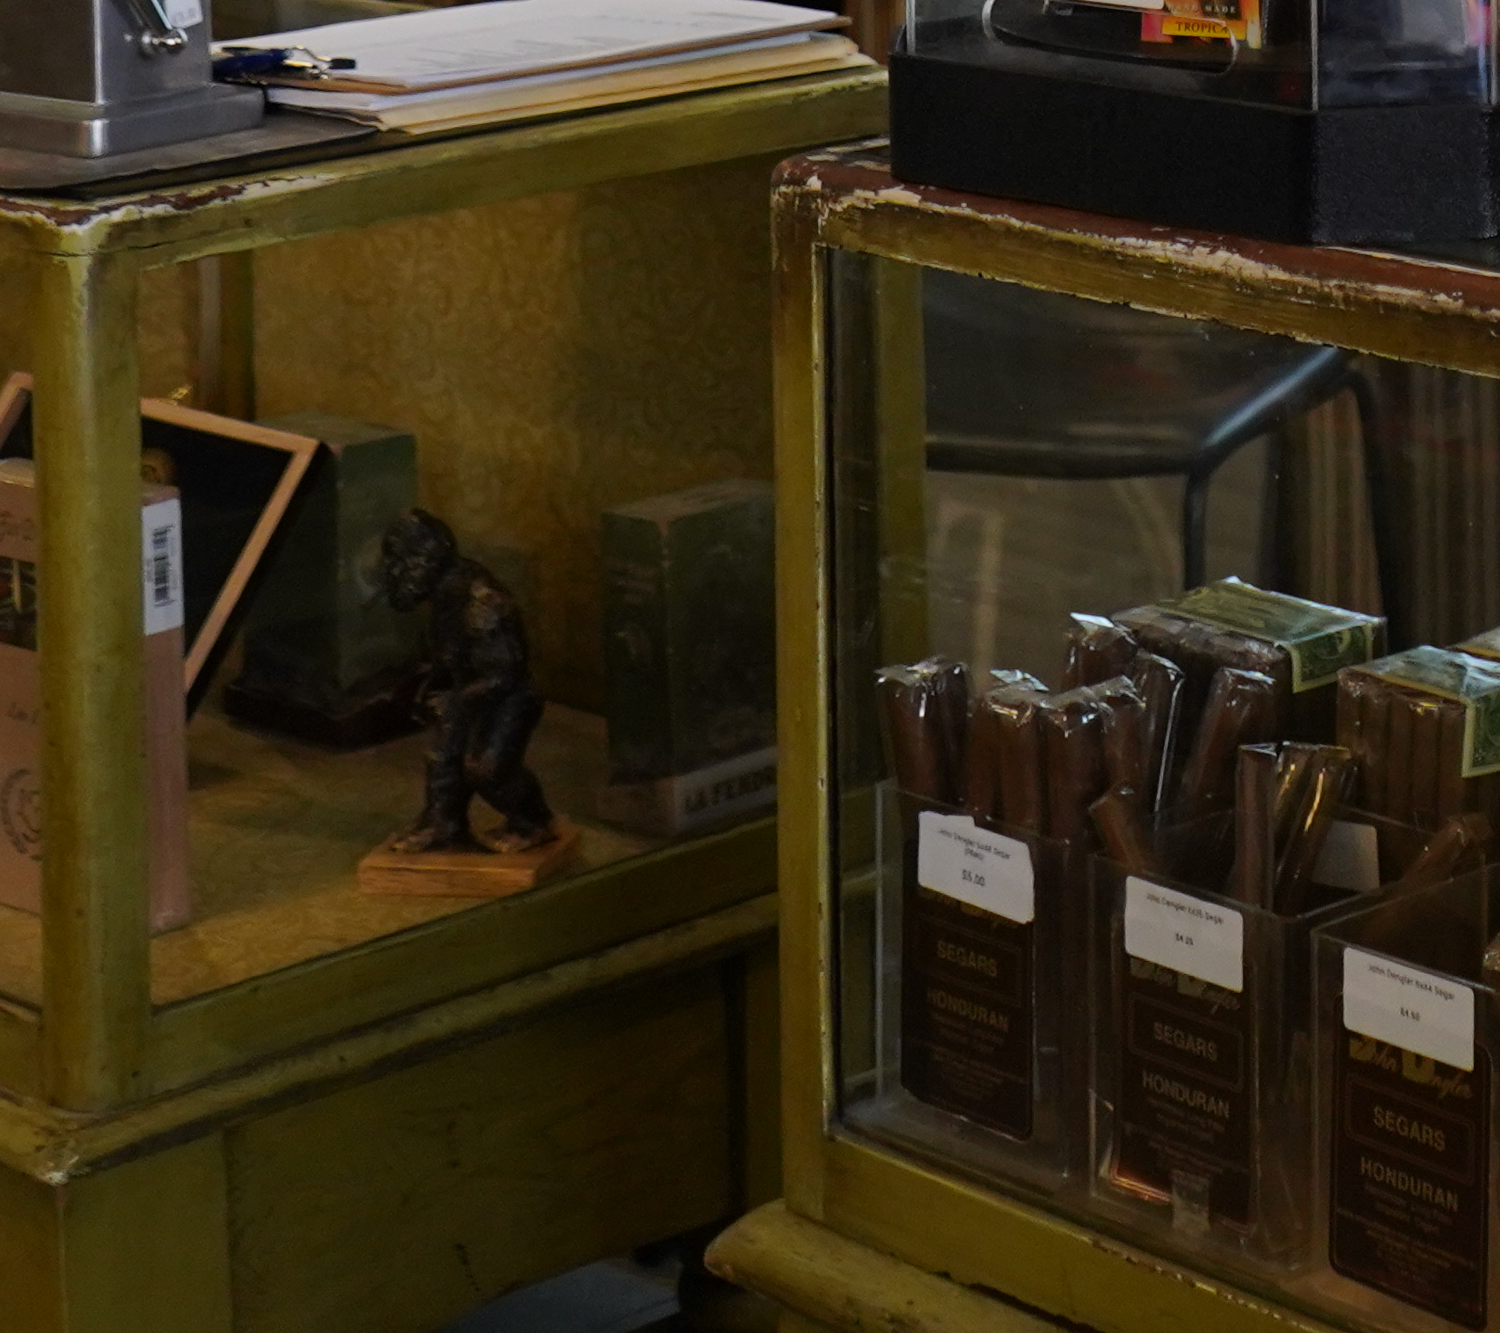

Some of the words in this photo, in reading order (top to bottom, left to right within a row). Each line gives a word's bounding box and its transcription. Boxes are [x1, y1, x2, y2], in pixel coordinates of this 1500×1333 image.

[1175, 20, 1231, 34] TROPICA
[935, 939, 998, 979] SEGARS
[926, 987, 1010, 1034] HONDURAN
[1153, 1020, 1219, 1062] SEGARS
[1141, 1069, 1230, 1120] HONDURAN
[1372, 1106, 1447, 1153] SEGARS
[1359, 1155, 1460, 1213] HONDURAN
